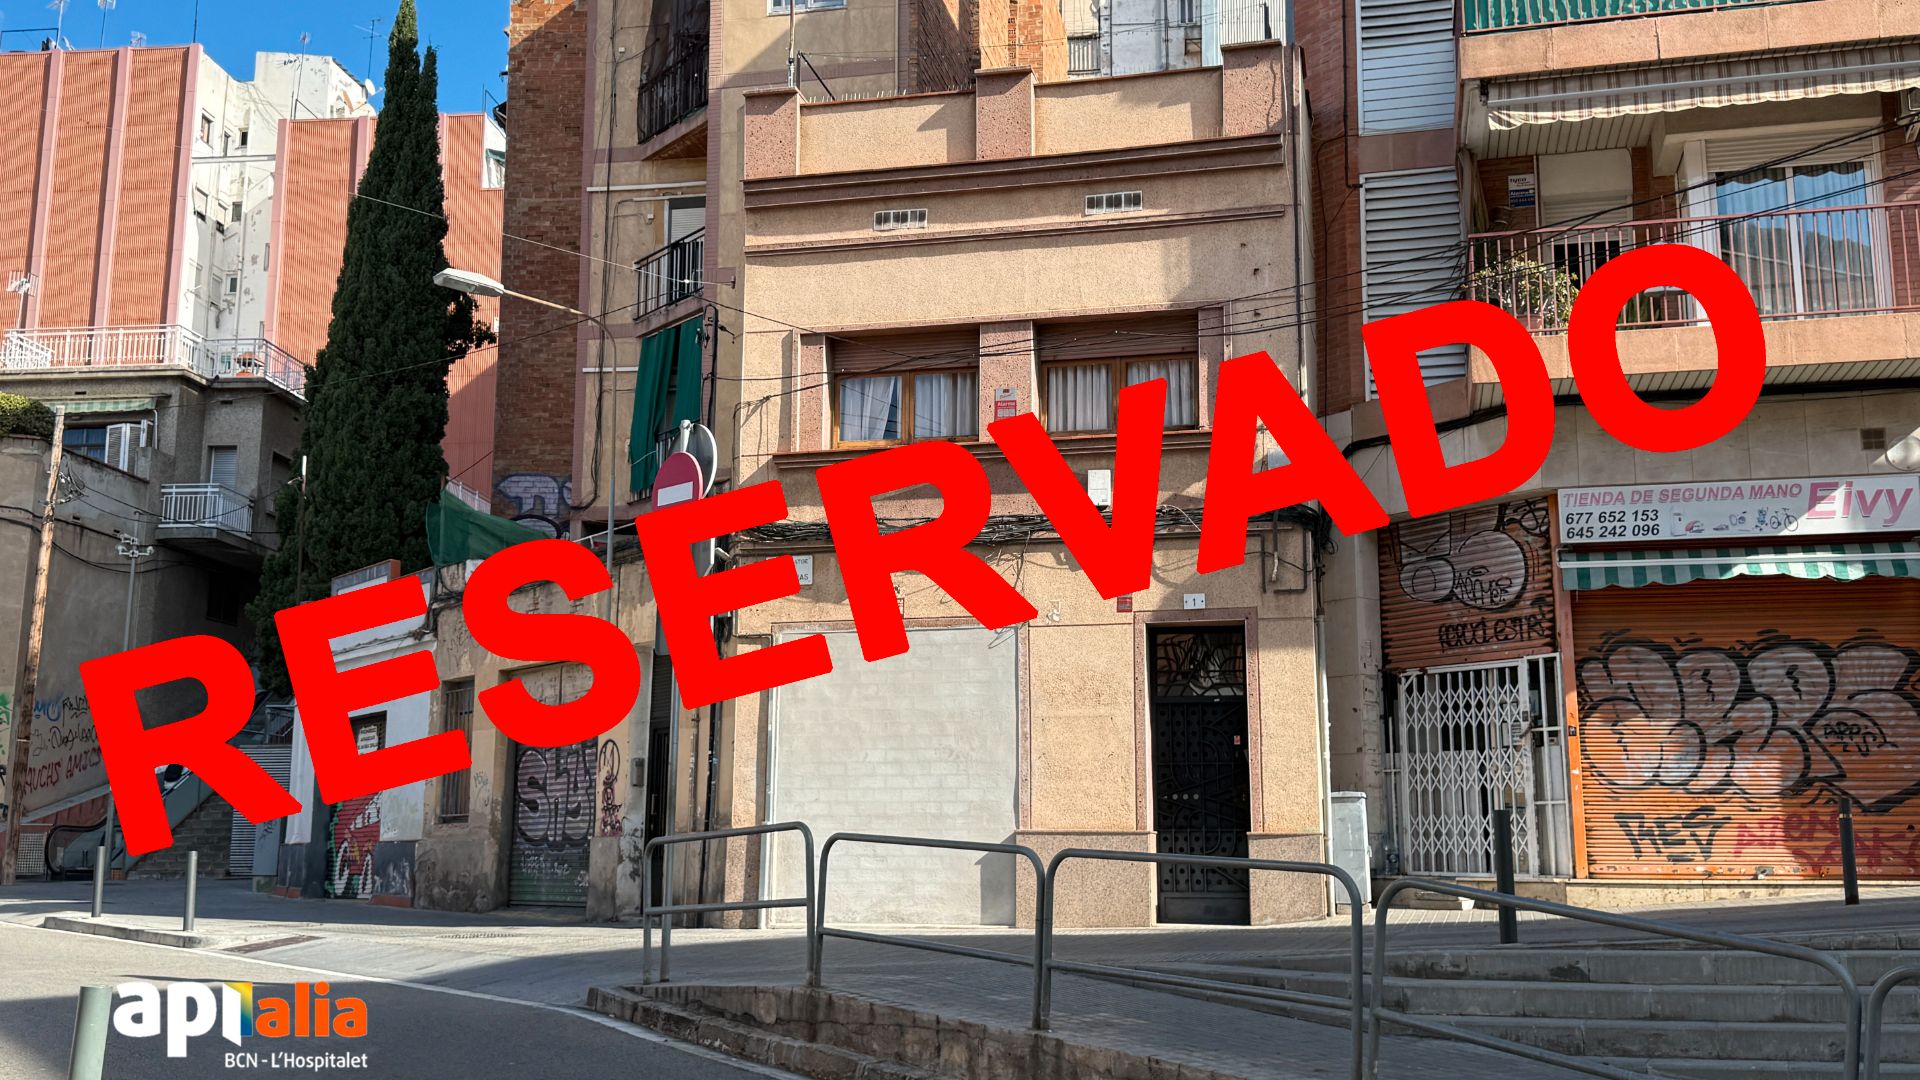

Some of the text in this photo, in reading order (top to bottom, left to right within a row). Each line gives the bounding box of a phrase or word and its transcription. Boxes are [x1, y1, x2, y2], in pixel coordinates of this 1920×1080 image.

[1563, 483, 1803, 508] TIENDA DE SEGUNDA MANO
[1565, 509, 1659, 525] 677 652 153
[1566, 523, 1660, 539] 645 242 096
[1192, 597, 1197, 607] 1
